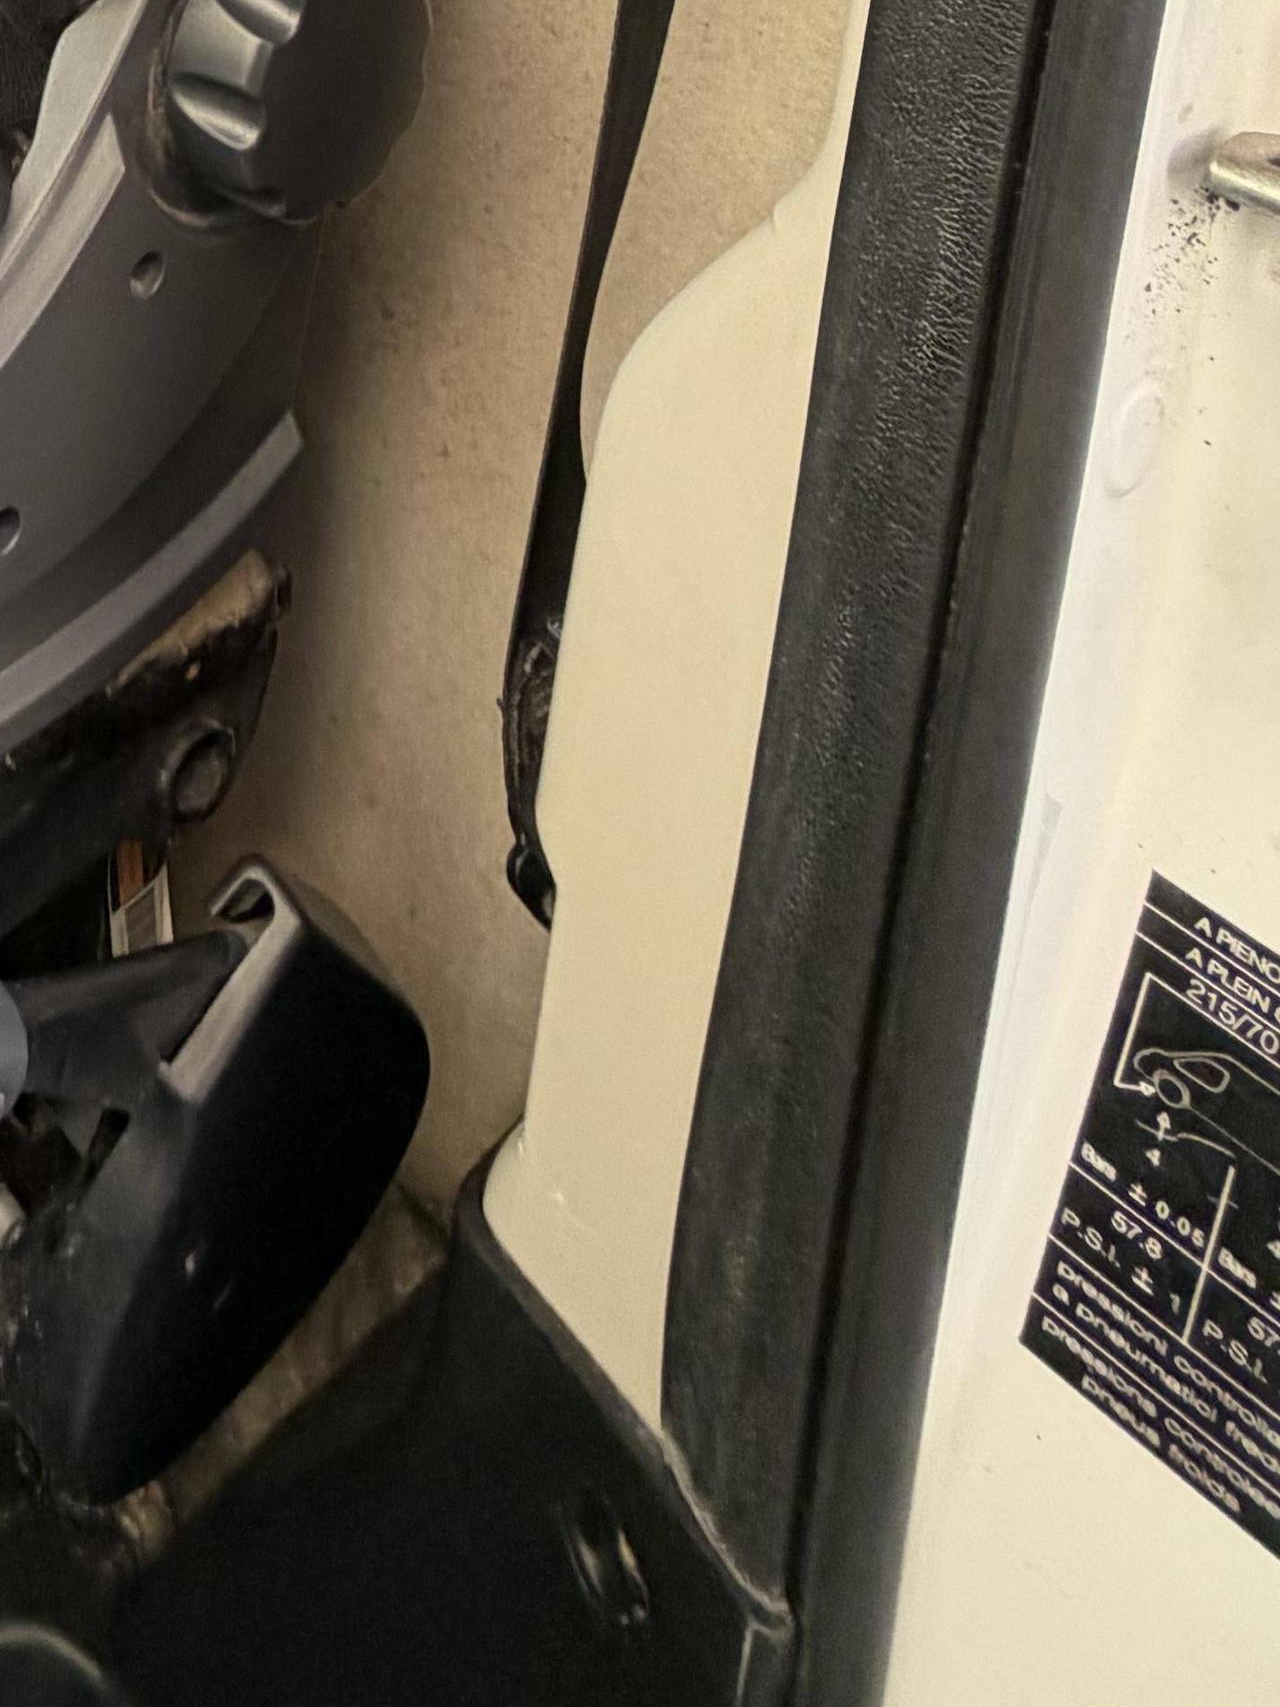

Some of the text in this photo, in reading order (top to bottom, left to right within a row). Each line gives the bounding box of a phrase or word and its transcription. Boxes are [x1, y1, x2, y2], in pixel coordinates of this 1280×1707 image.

[1185, 948, 1271, 1014] A PLEIN
[1194, 917, 1280, 984] A PIENO
[1185, 979, 1279, 1054] 215/70
[1110, 1210, 1163, 1260] 57.8
[1155, 1200, 1204, 1248] 0.05
[1057, 1261, 1168, 1357] pressioni
[1042, 1315, 1158, 1418] pressions
[1075, 1302, 1218, 1423] pneumatici
[1081, 1374, 1160, 1448] pneus
